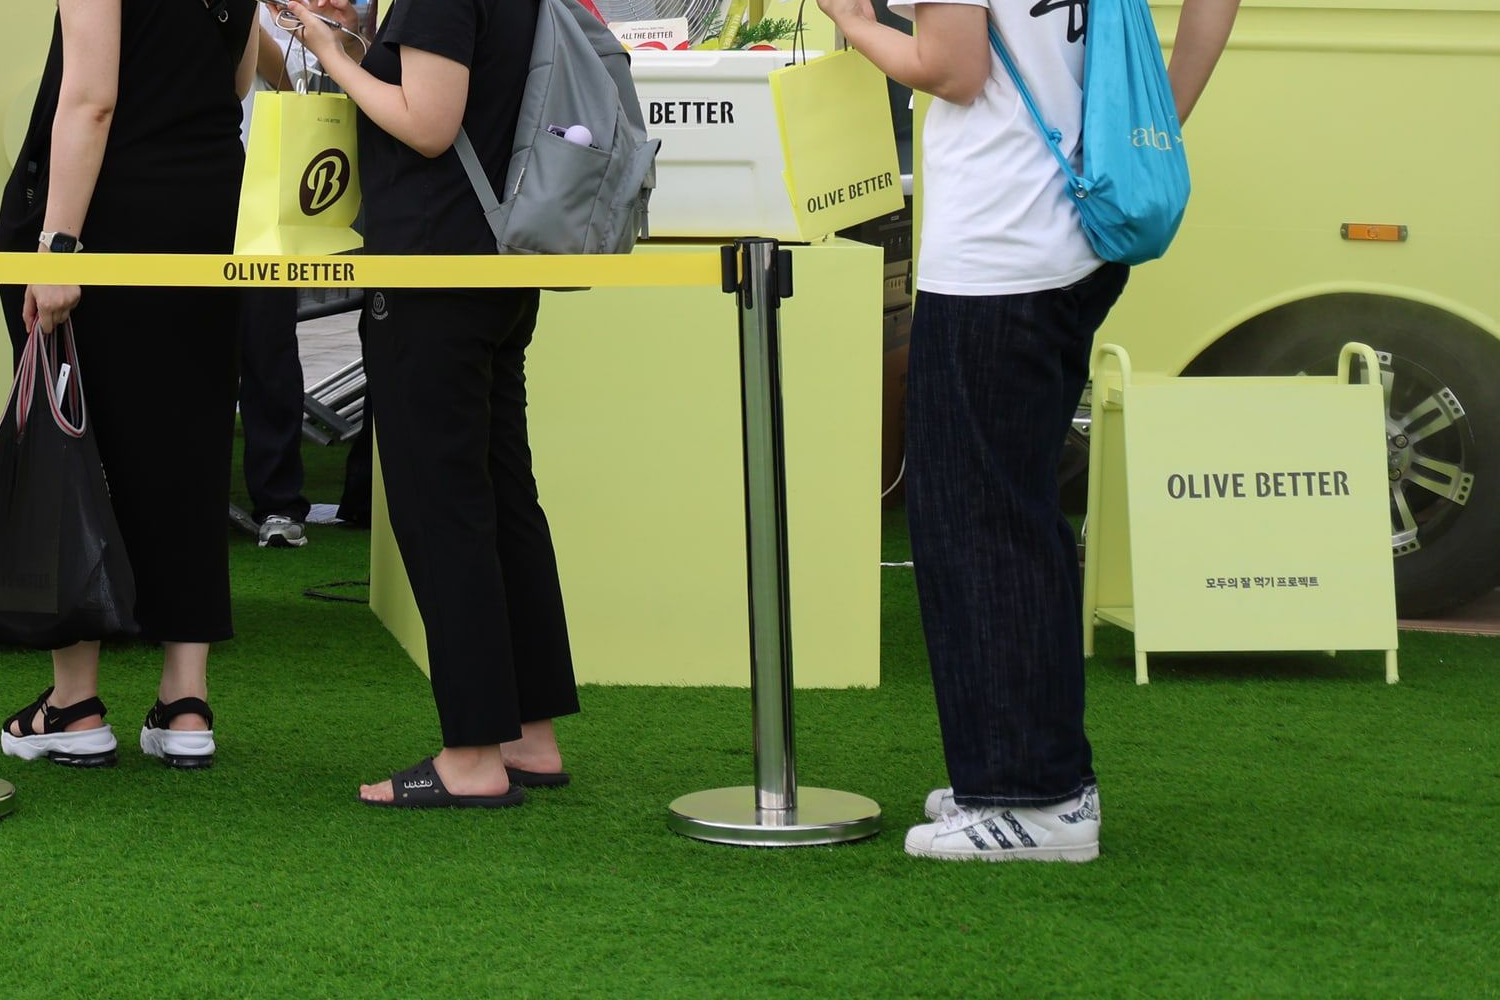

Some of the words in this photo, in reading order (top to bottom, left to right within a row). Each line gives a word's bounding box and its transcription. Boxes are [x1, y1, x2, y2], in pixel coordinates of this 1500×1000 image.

[647, 31, 673, 40] BETTER
[650, 101, 734, 125] BETTER
[807, 187, 846, 213] OLIVE
[848, 172, 893, 200] BETTER
[223, 262, 280, 281] OLIVE
[287, 262, 355, 281] BETTER
[1167, 474, 1246, 499] OLIVE
[1255, 471, 1350, 498] BETTER
[1206, 577, 1238, 589] 모두의
[1240, 576, 1251, 588] 잘
[1254, 576, 1275, 588] 먹기
[1277, 576, 1319, 588] 프로젝트
